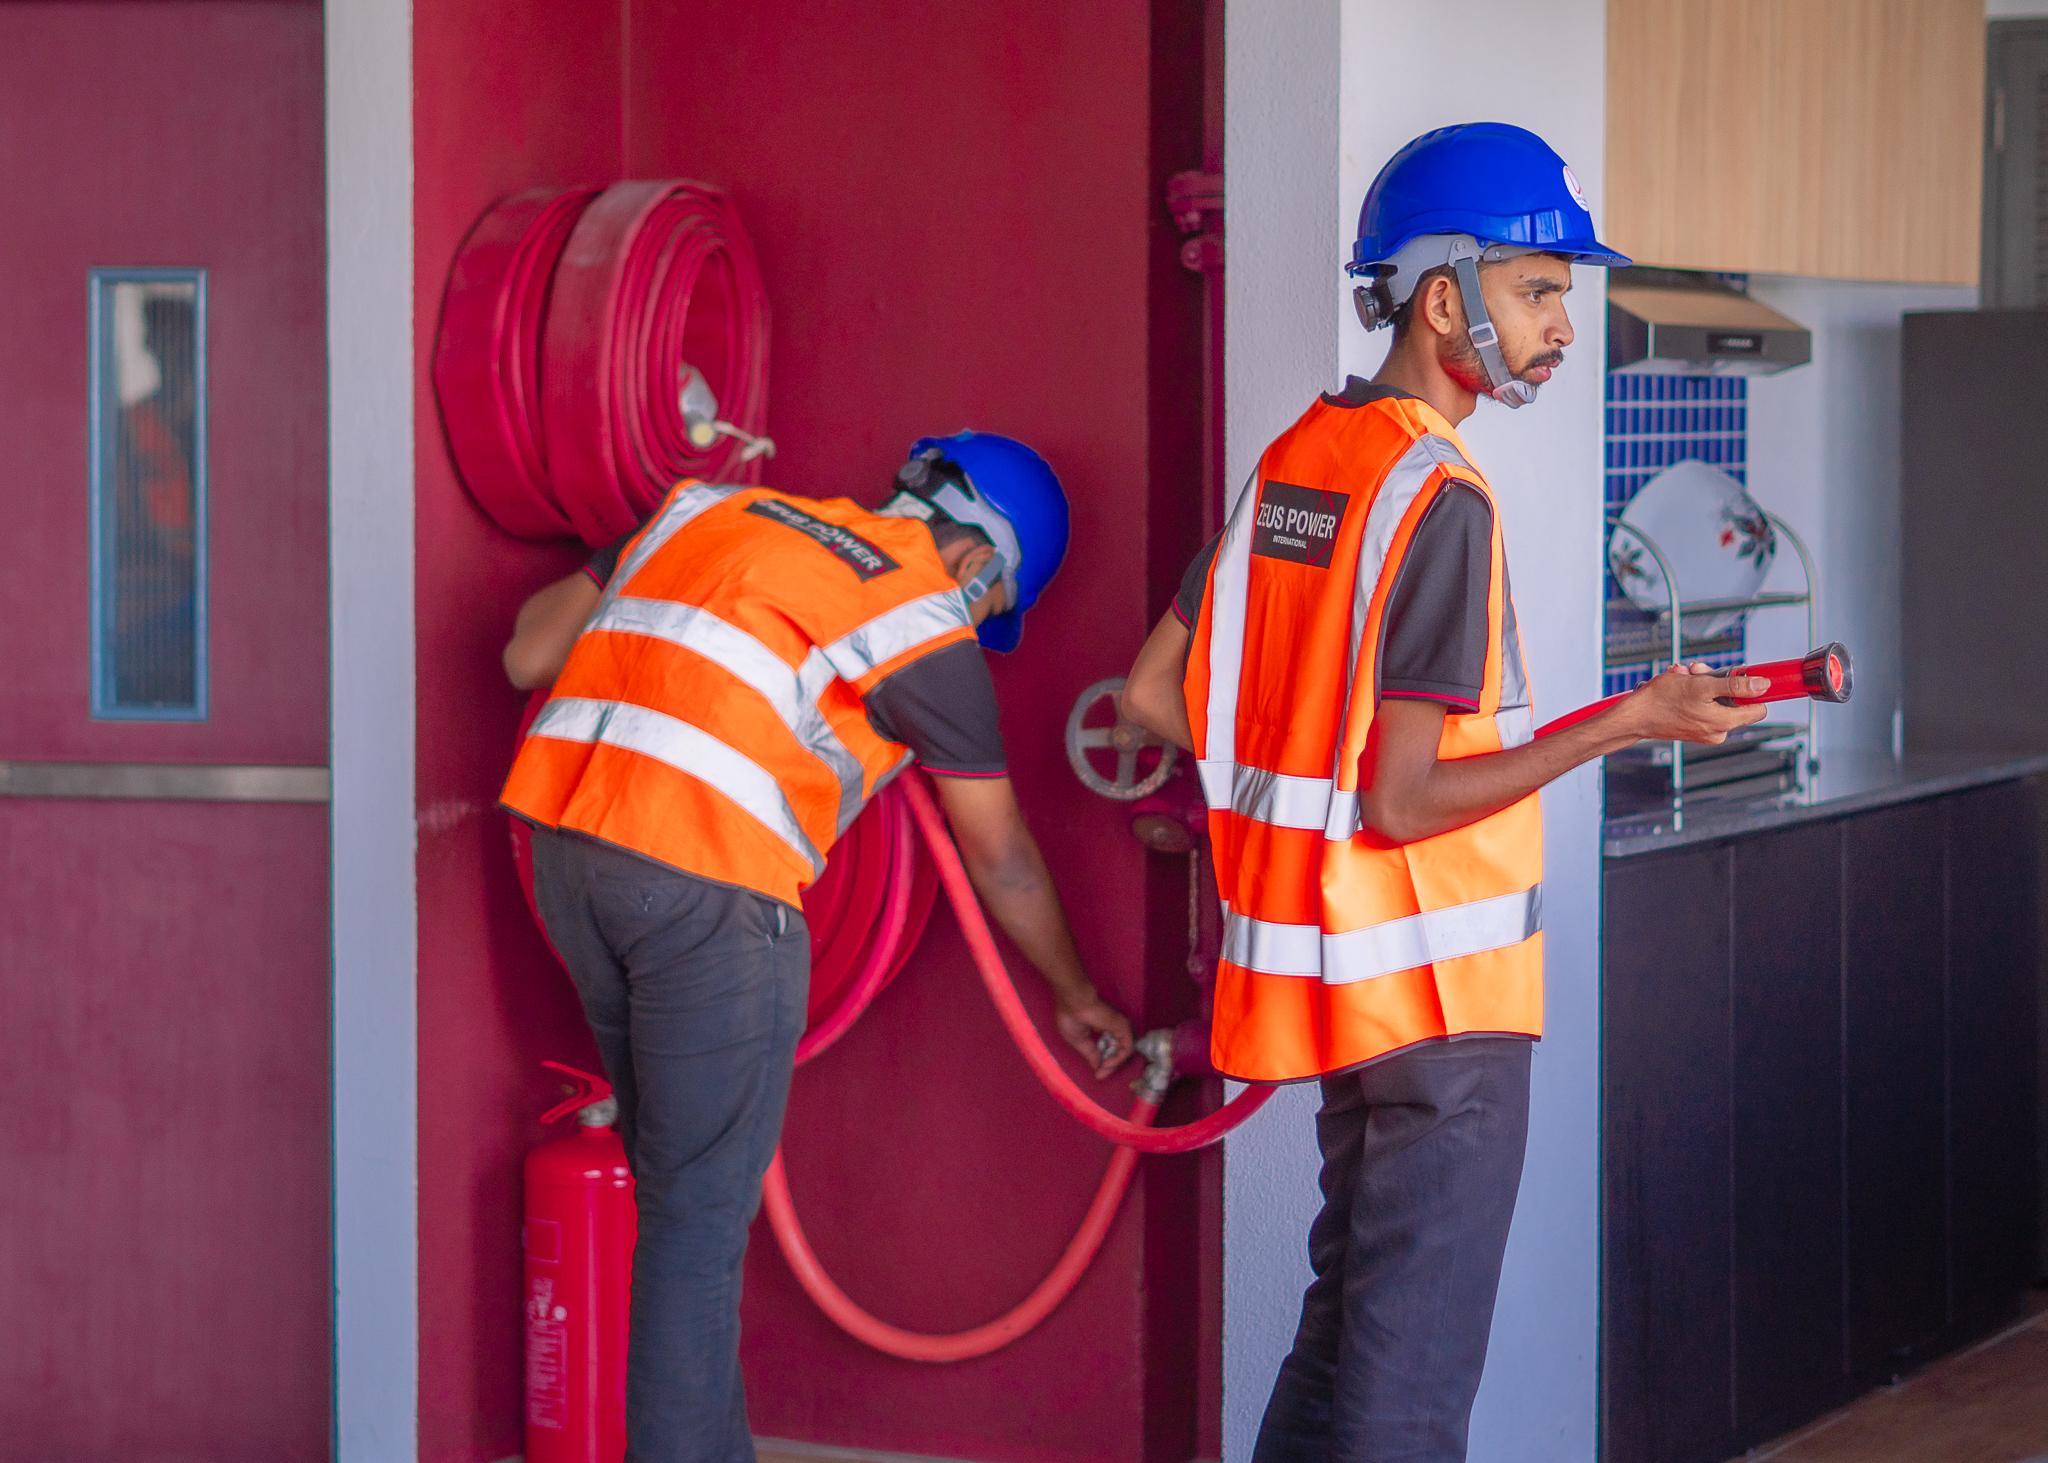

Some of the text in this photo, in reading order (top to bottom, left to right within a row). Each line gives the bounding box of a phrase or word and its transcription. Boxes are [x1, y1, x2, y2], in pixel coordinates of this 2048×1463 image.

[1256, 503, 1336, 539] ZEUS POWER
[806, 523, 882, 570] POWER
[1272, 535, 1307, 549] INTERNATIONAL
